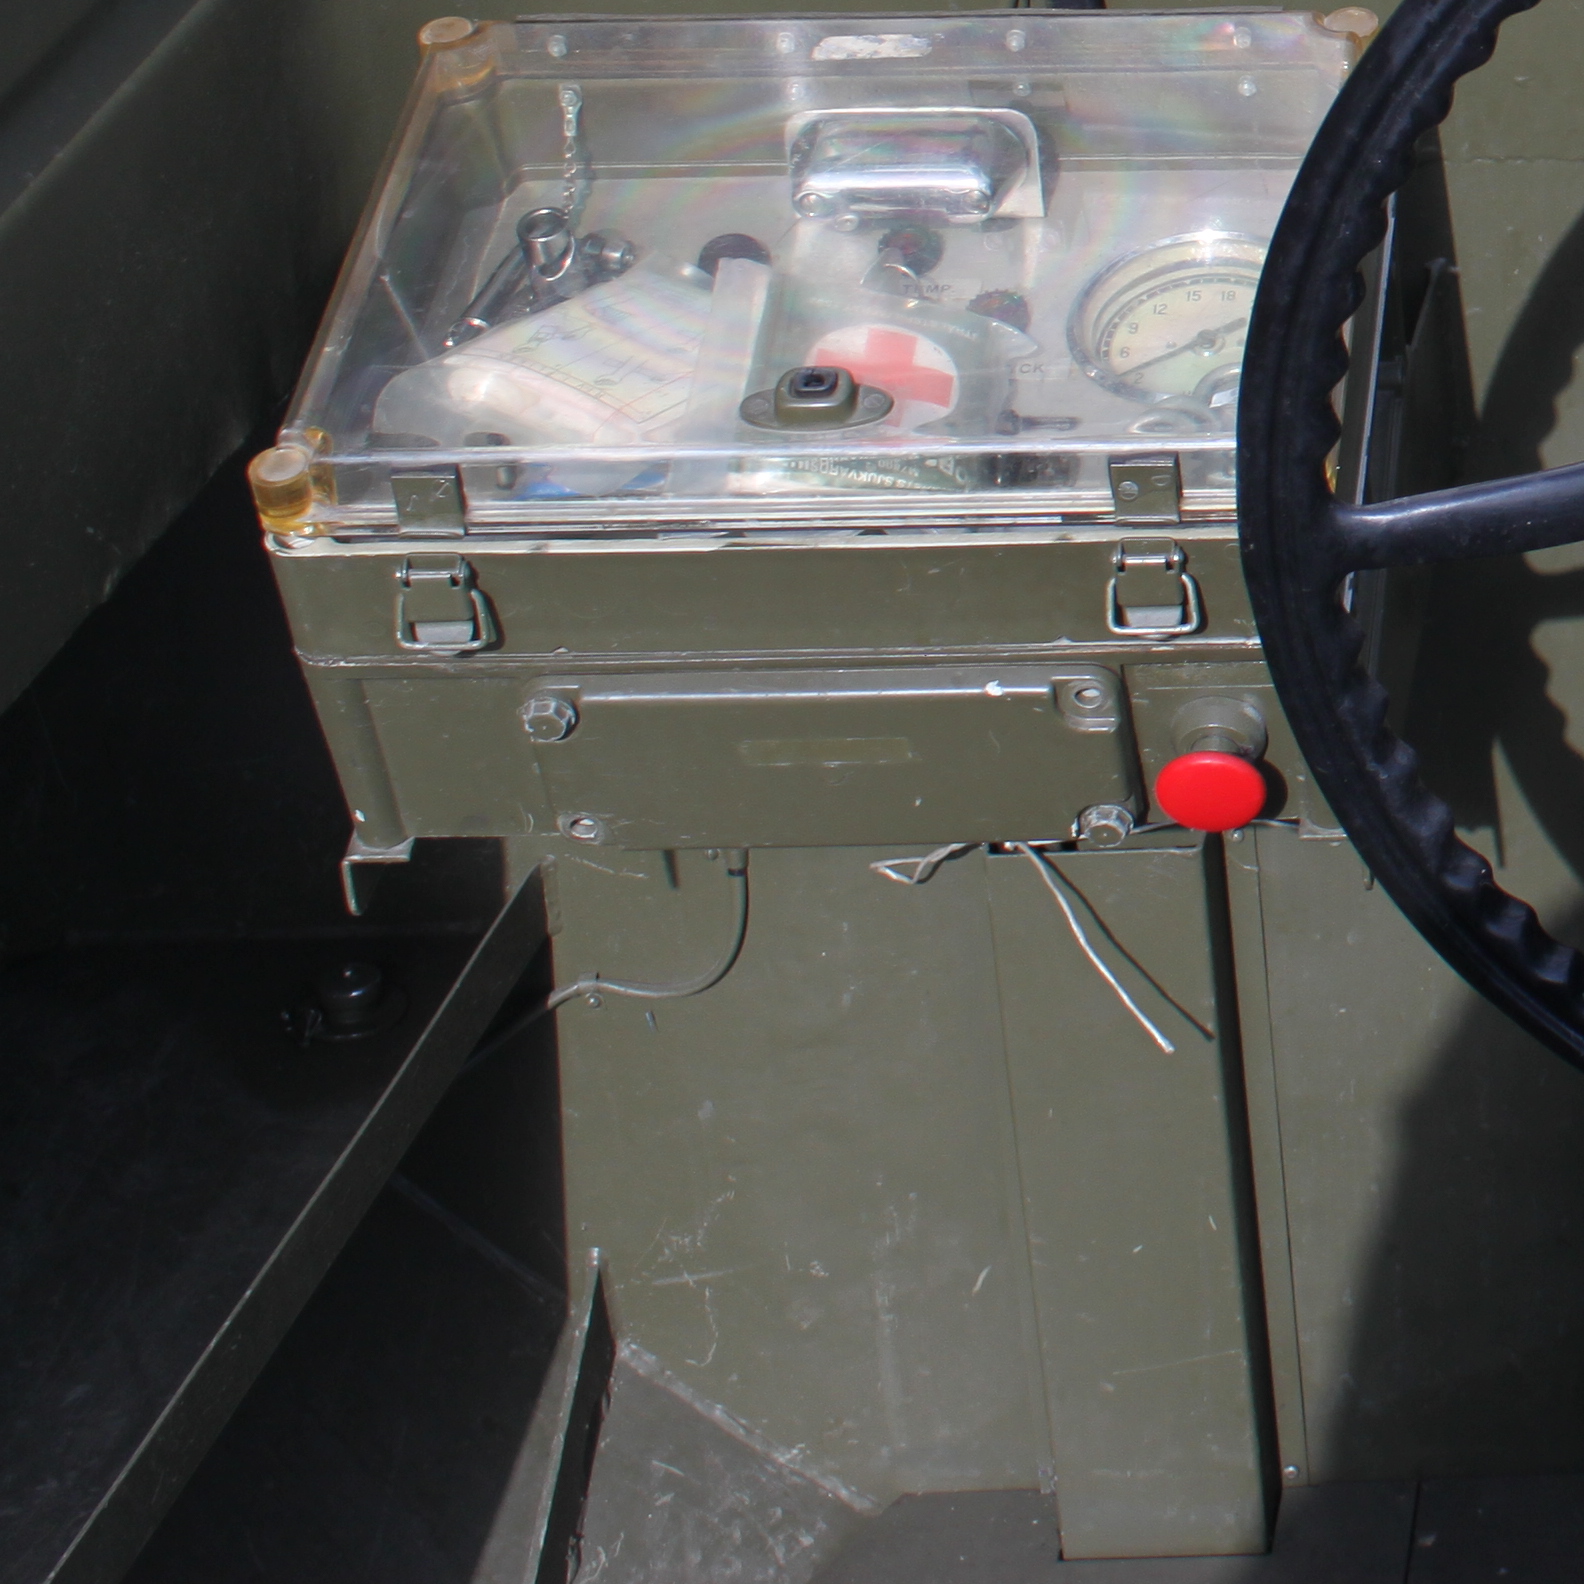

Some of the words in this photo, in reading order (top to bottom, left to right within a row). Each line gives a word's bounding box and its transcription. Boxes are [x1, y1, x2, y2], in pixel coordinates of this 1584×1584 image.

[1186, 290, 1202, 302] 15
[1221, 290, 1236, 302] 18
[1153, 303, 1168, 315] 12
[1129, 323, 1139, 334] 9
[1120, 347, 1130, 358] 6
